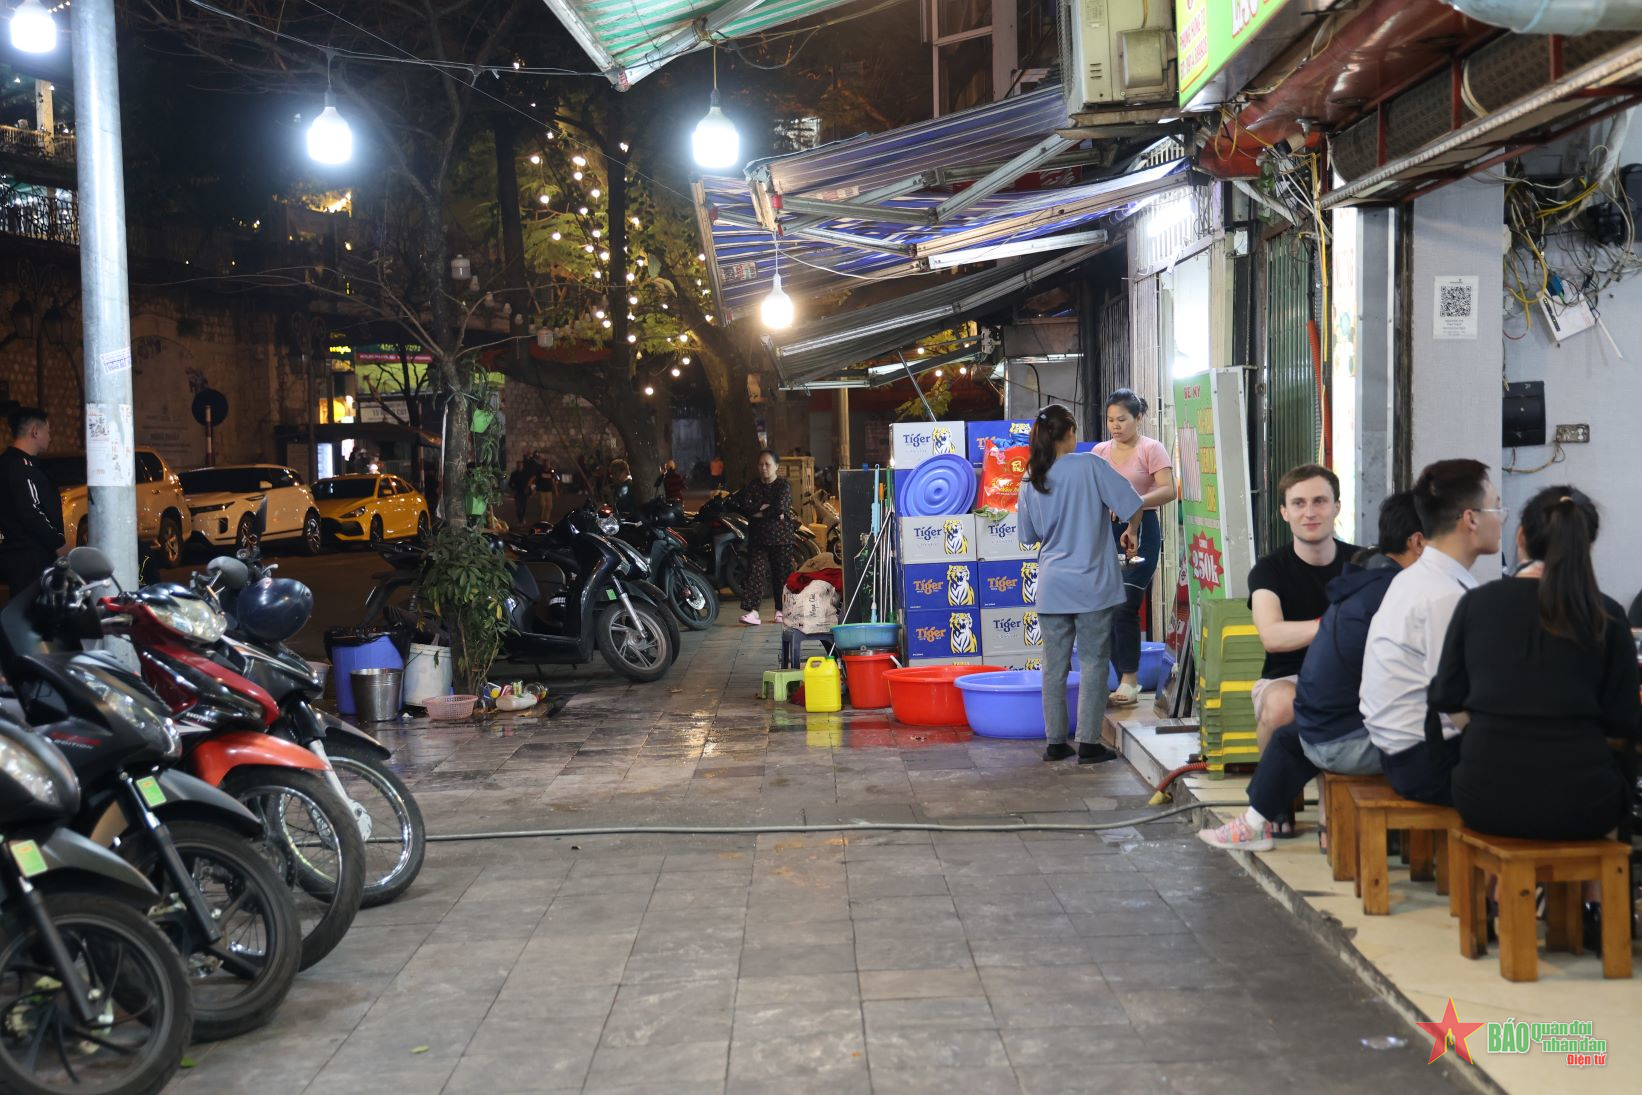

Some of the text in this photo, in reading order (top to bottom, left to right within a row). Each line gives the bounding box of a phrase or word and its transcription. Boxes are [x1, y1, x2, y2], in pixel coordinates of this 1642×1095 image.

[903, 433, 931, 448] Tiger
[913, 526, 943, 541] Tiger
[988, 523, 1017, 538] Tiger
[1192, 550, 1219, 584] 250k
[913, 579, 944, 595] Tiger
[987, 576, 1018, 592] Tiger
[993, 618, 1021, 633] Tiger
[916, 626, 947, 642] Tiger
